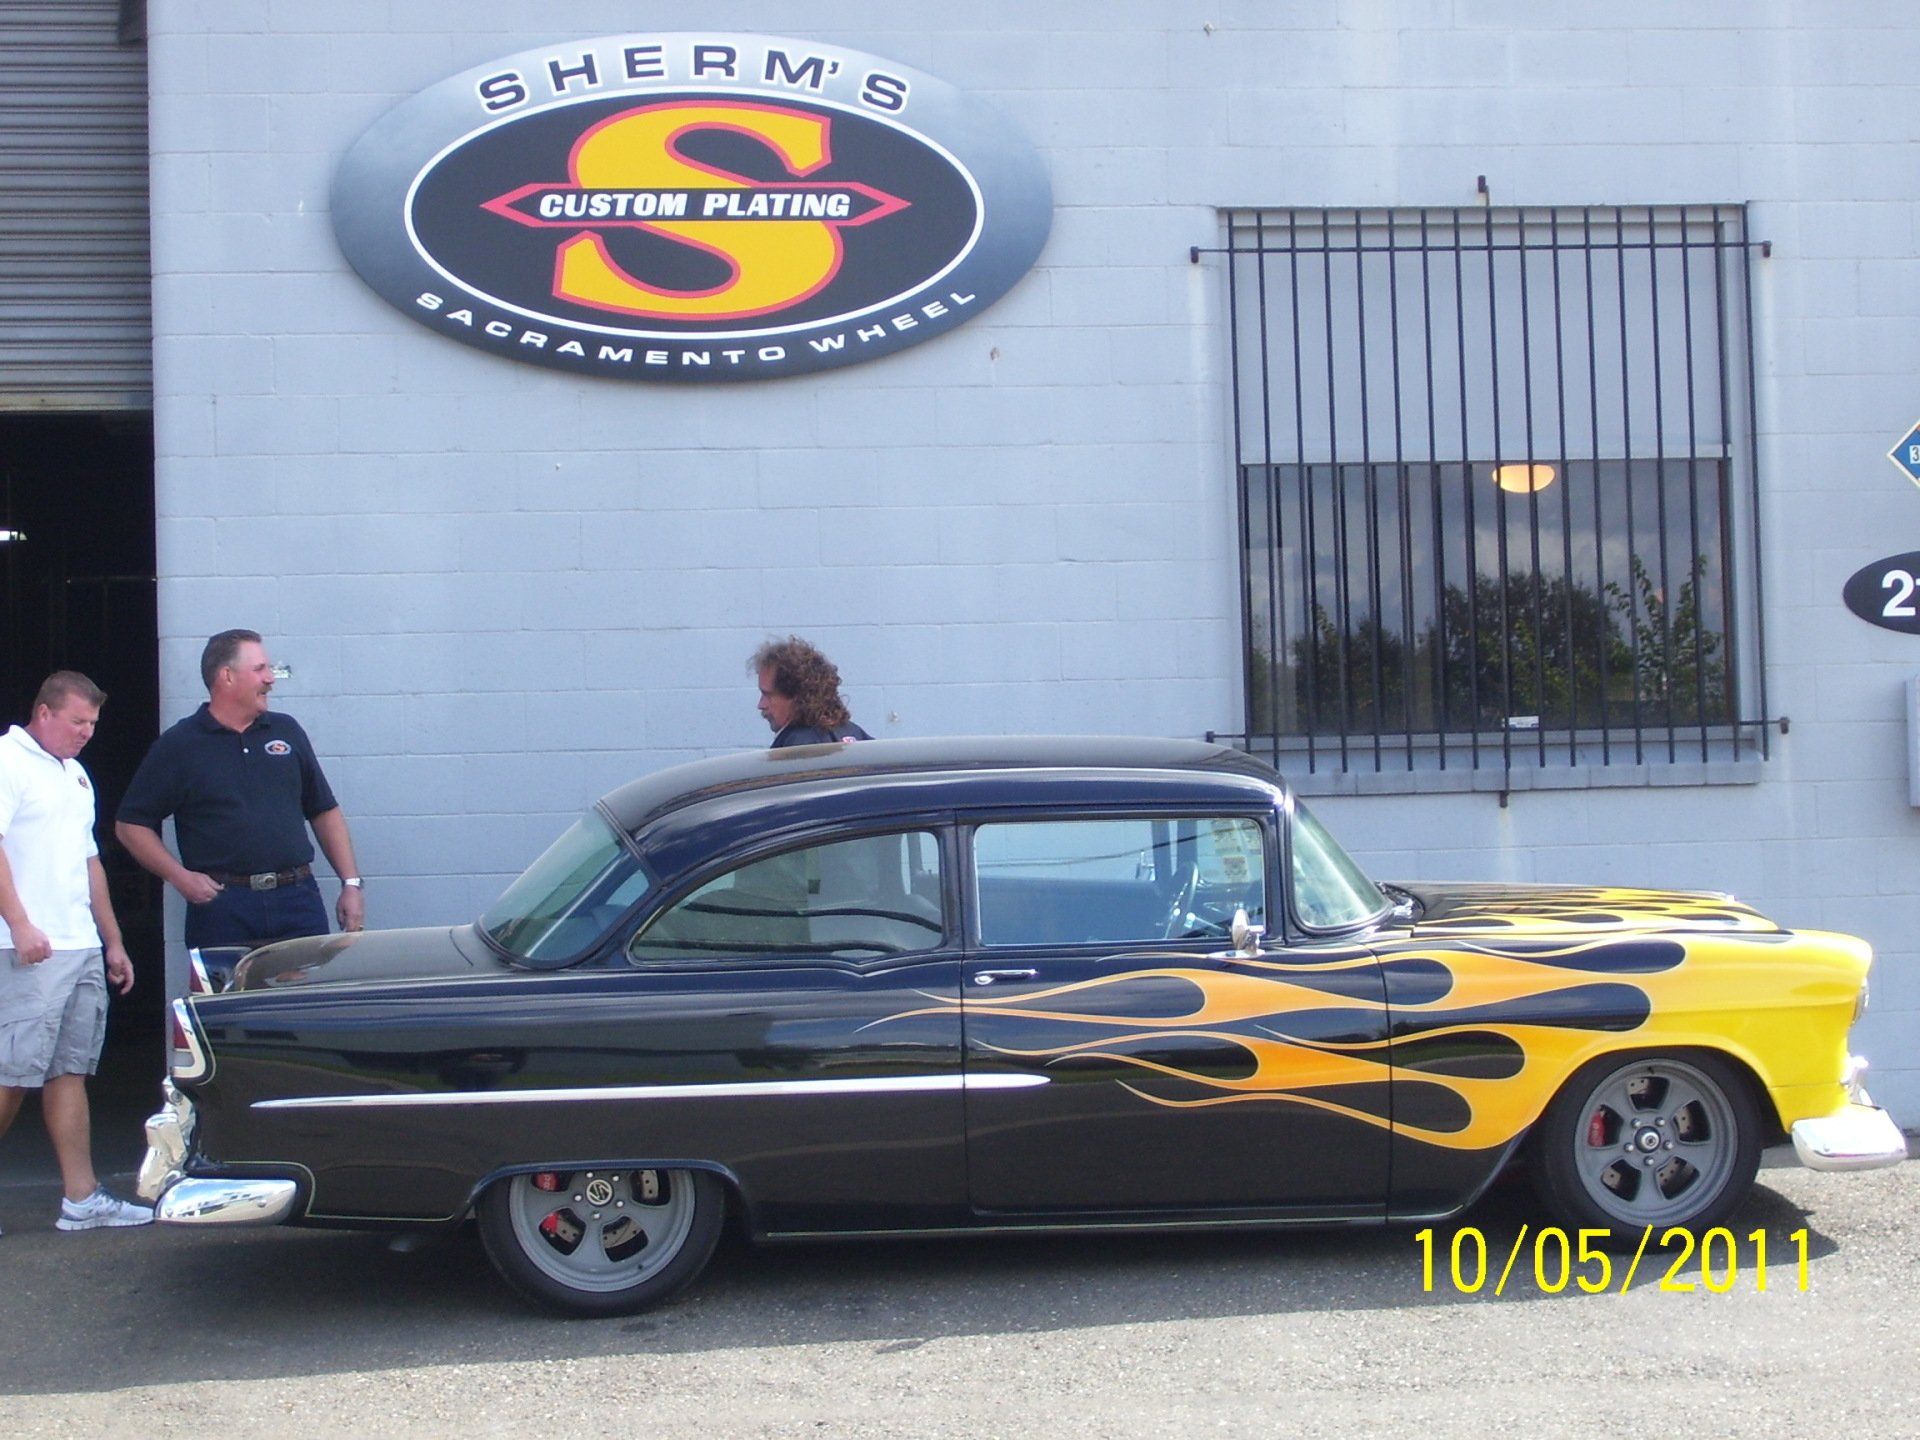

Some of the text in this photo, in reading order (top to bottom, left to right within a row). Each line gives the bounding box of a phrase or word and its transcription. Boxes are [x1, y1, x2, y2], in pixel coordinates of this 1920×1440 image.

[478, 44, 908, 111] SHERM'S
[539, 193, 850, 217] CUSTOM PLATING
[551, 99, 843, 321] S
[416, 292, 976, 365] SACRAMENTO WHEEL
[1912, 446, 1920, 462] 3
[1882, 569, 1920, 617] 2
